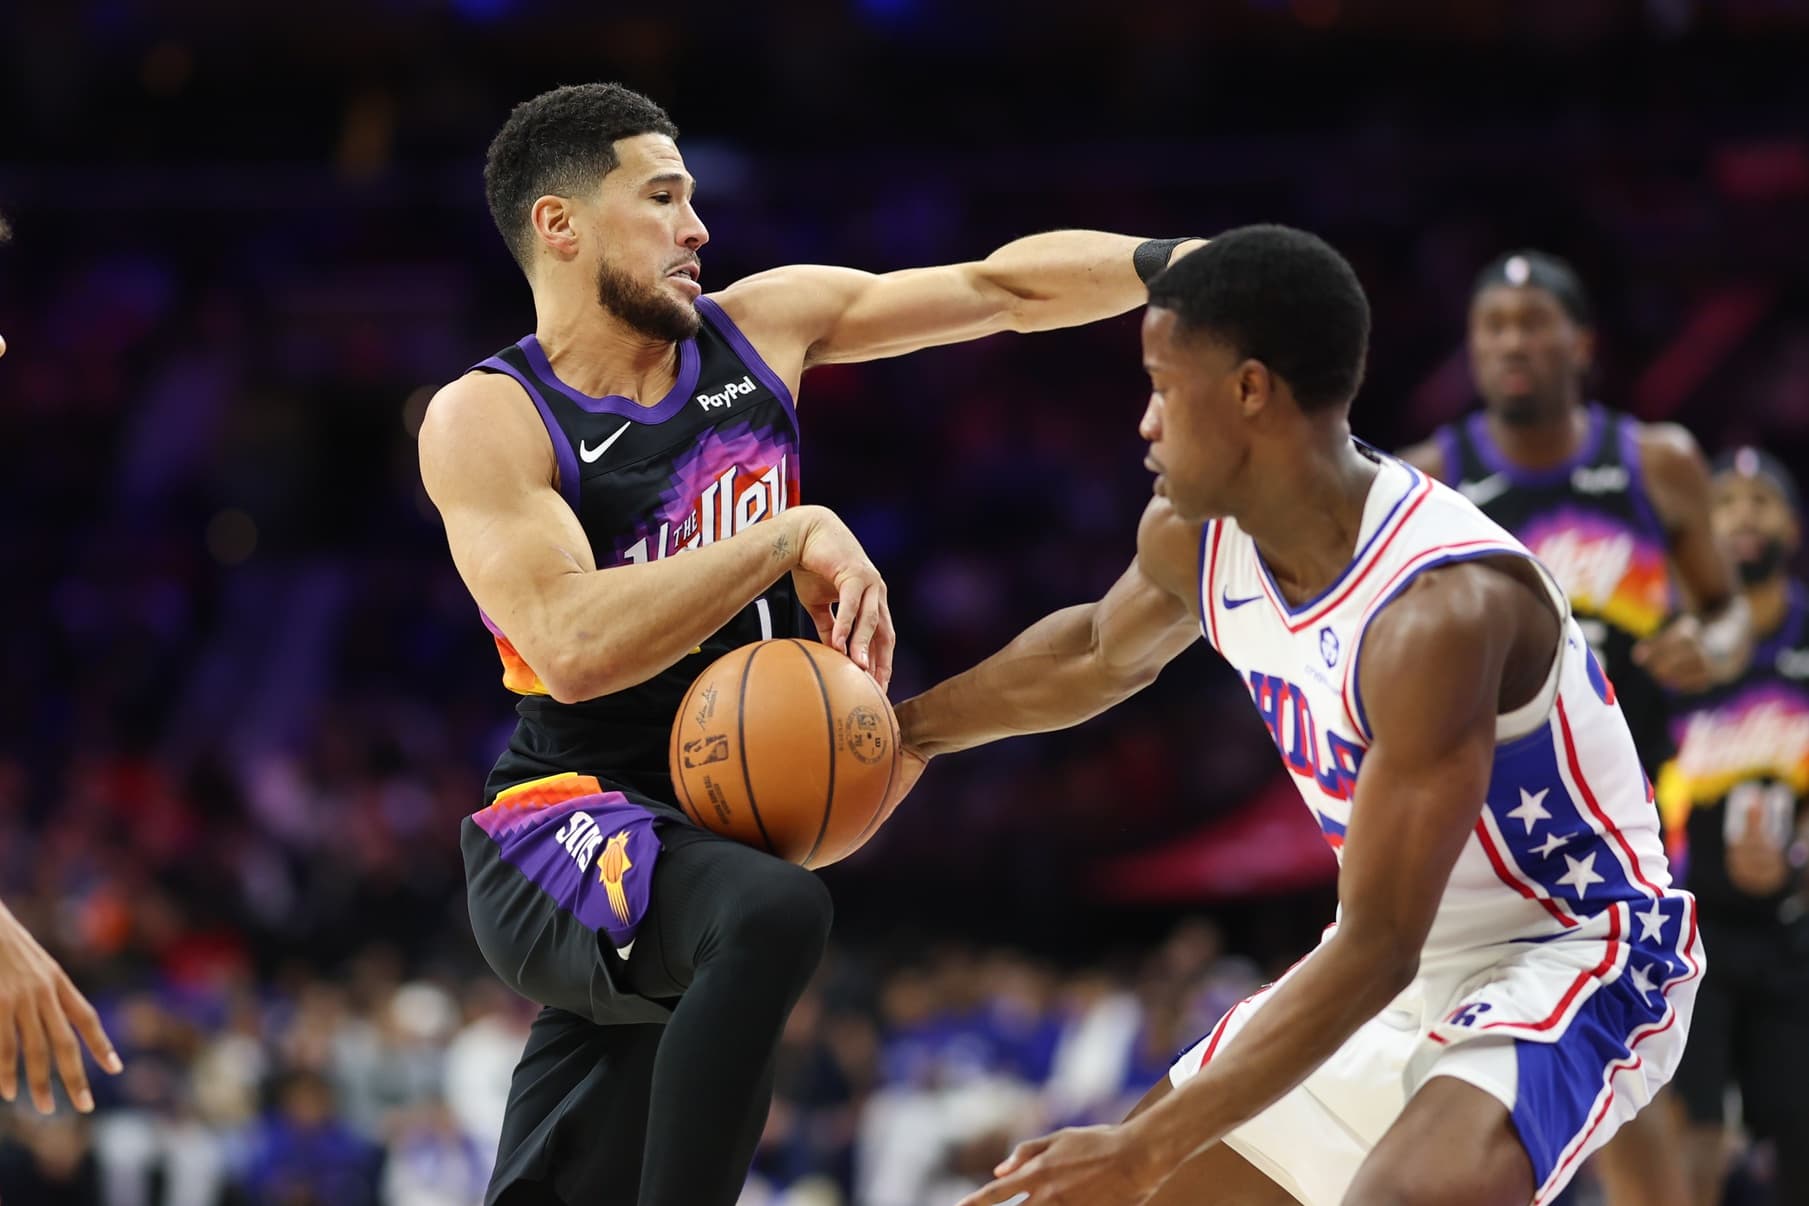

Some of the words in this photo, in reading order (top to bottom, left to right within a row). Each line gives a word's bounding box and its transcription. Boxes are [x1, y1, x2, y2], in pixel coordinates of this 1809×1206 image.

[696, 375, 757, 412] PayPal
[624, 453, 788, 564] lley
[673, 510, 698, 548] THE
[555, 811, 603, 873] SUNS
